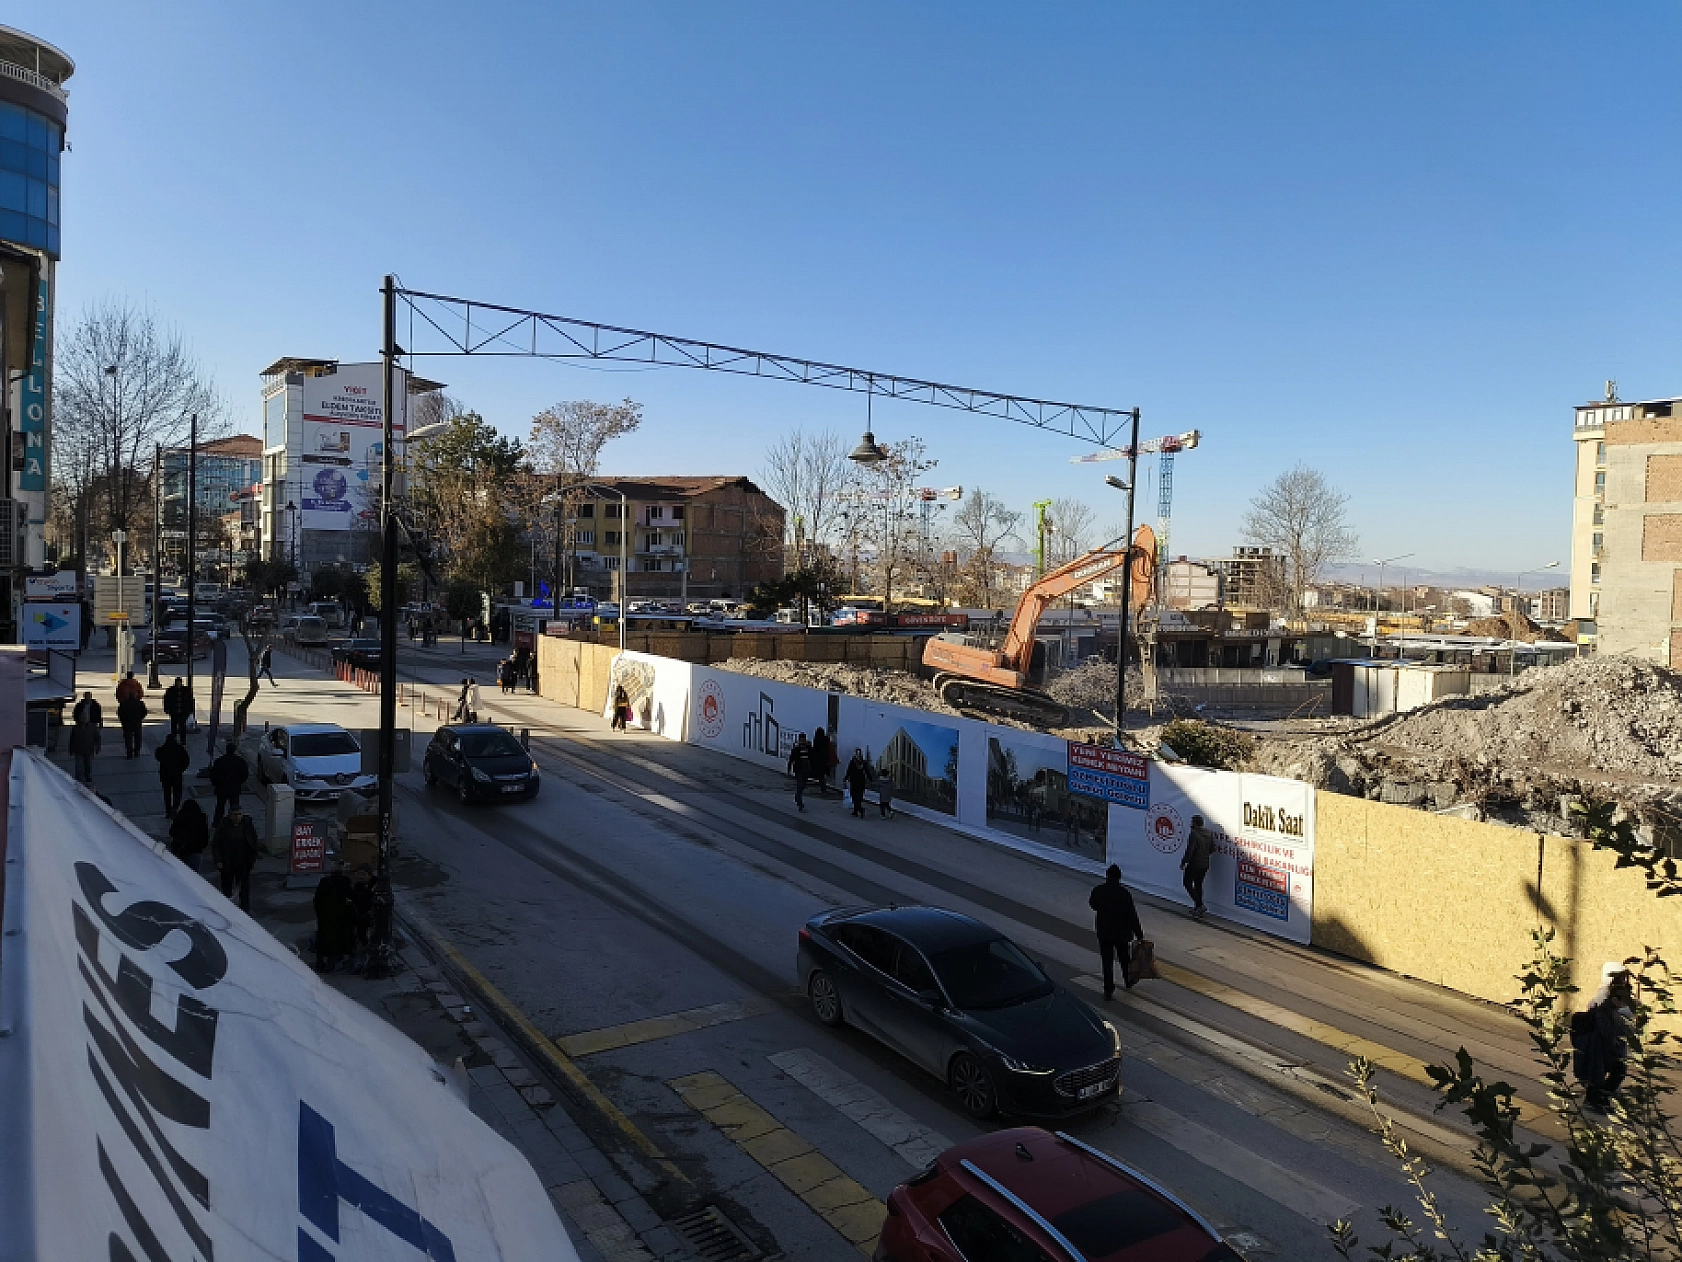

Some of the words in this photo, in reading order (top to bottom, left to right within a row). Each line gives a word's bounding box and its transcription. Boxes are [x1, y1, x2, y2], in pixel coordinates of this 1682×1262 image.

[27, 295, 45, 476] BELLONA
[1072, 746, 1097, 757] YENİ
[1243, 801, 1276, 832] Dakik
[1278, 807, 1304, 837] Saat
[295, 826, 314, 836] BAY
[1282, 847, 1295, 860] VE
